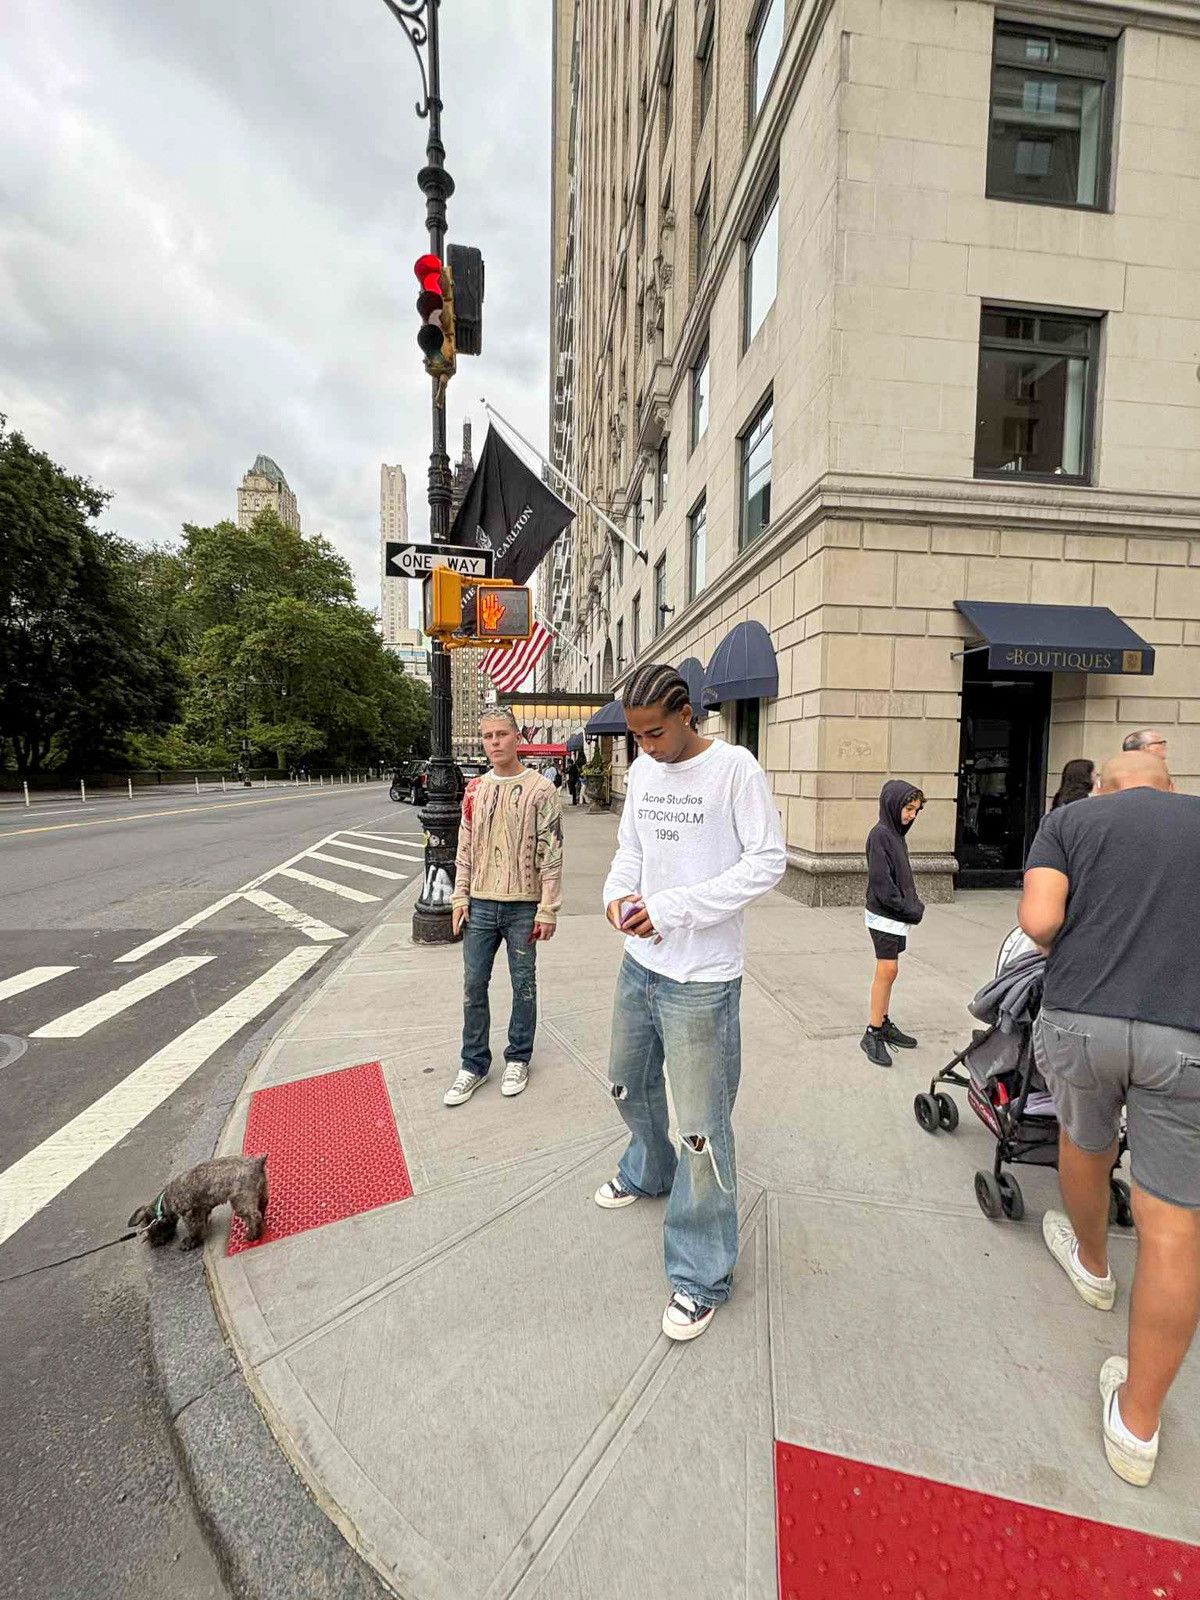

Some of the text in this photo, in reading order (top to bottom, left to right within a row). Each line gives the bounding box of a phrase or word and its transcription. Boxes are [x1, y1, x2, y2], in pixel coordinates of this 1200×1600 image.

[402, 554, 479, 573] ONE WAY
[1007, 649, 1112, 671] BOUTIQUES
[642, 792, 703, 805] Acne Studios
[638, 808, 704, 824] STOCKHOLM
[655, 828, 680, 842] 1996
